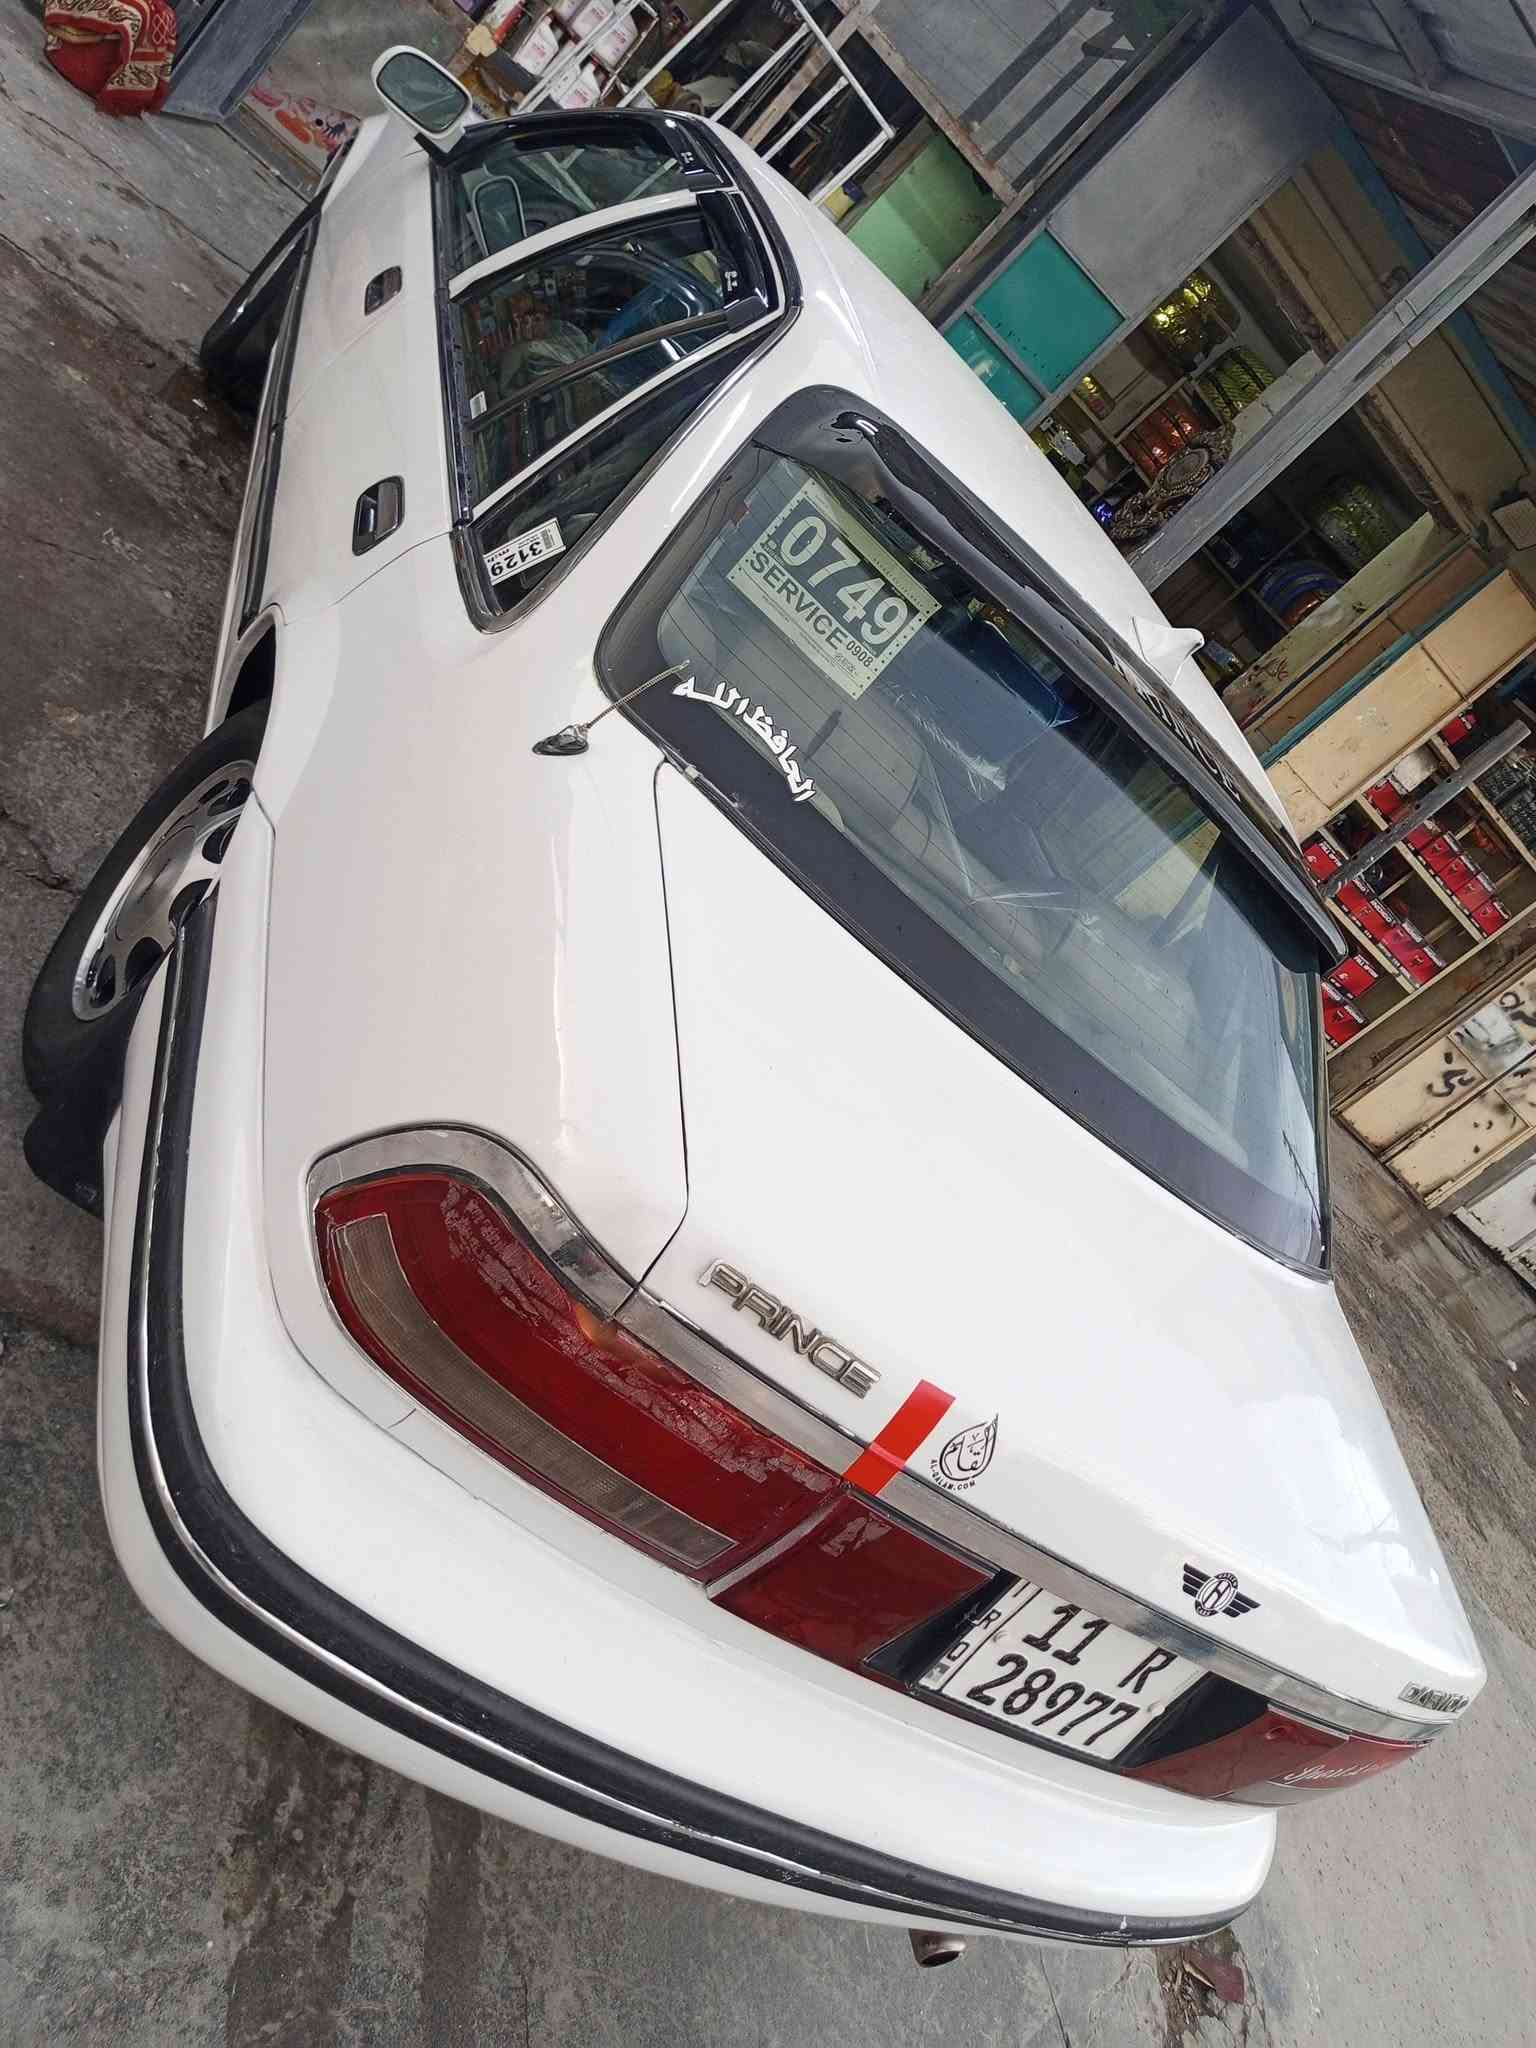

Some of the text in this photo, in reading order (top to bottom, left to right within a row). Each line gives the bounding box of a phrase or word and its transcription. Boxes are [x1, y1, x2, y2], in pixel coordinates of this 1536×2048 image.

[491, 541, 543, 577] 3129
[749, 550, 848, 650] SERVICE
[846, 640, 874, 668] 0908
[781, 516, 908, 645] 0749
[672, 676, 817, 802] الحافظ الله
[698, 1258, 881, 1398] PRINCE
[966, 1653, 1140, 1747] 28977
[1022, 1603, 1178, 1694] 11 R
